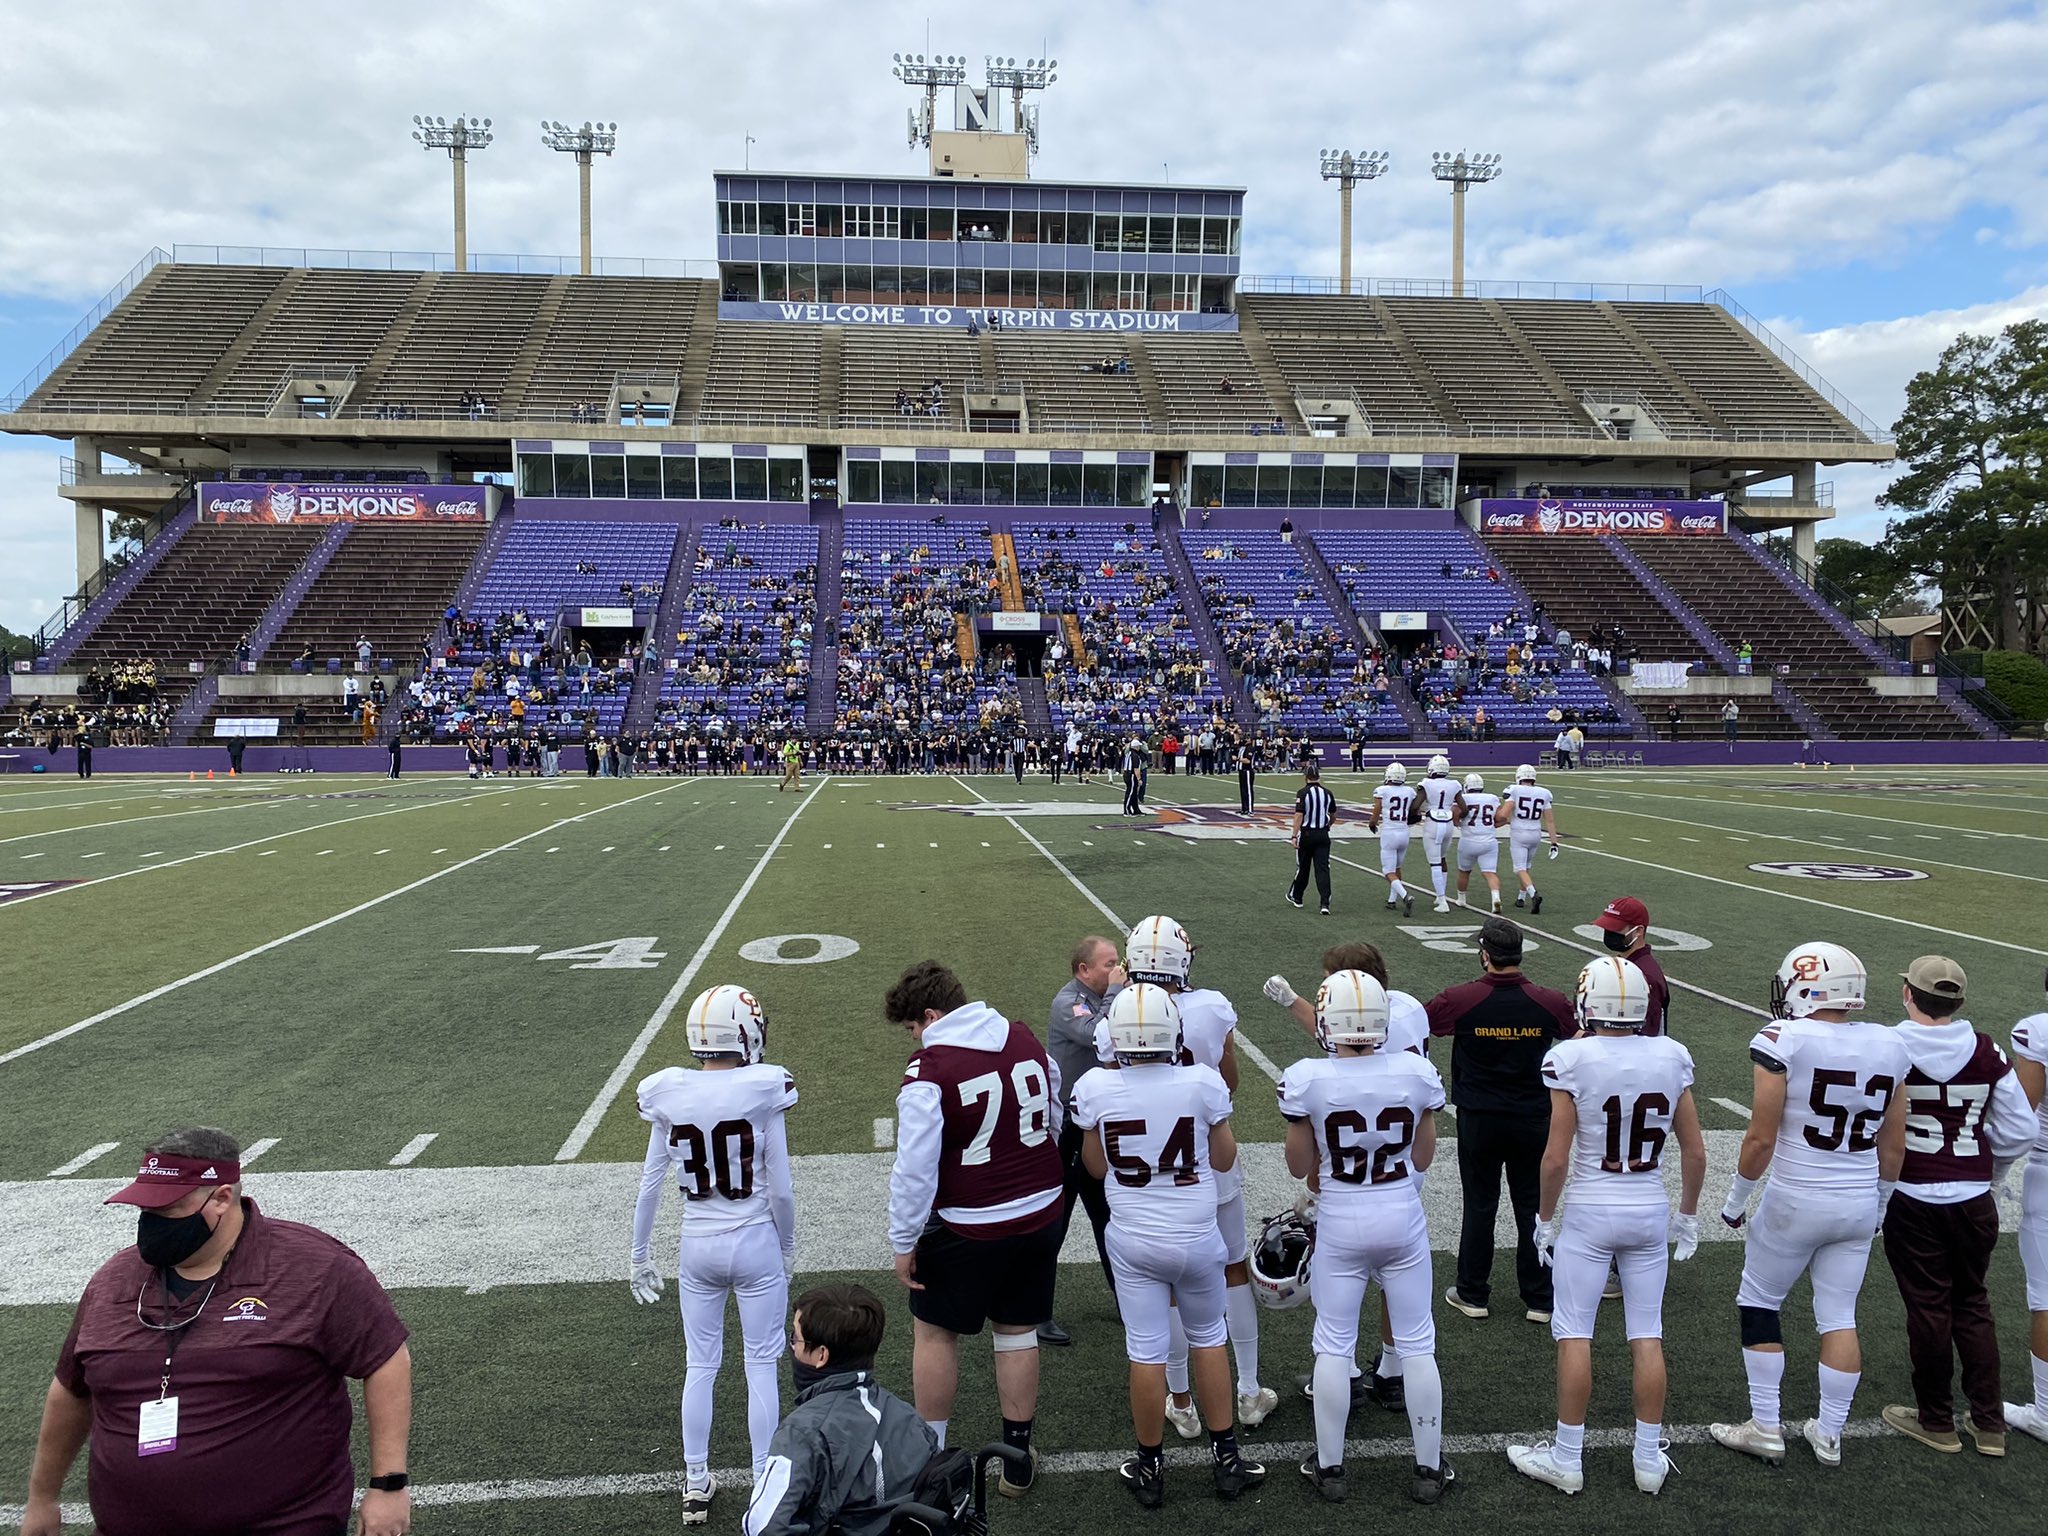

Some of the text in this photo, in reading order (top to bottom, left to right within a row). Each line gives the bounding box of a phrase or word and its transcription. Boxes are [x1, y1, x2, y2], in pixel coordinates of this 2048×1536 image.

[955, 84, 998, 131] N
[780, 304, 906, 325] WELCOME
[920, 307, 952, 325] TO
[1070, 311, 1181, 331] STADIUM
[299, 496, 416, 518] DEMONS
[1565, 510, 1665, 529] DEMONS
[1389, 796, 1409, 822] 21
[1438, 790, 1445, 810] 1
[1517, 796, 1545, 821] 56
[1467, 804, 1494, 827] 76
[1136, 973, 1172, 982] Riddell
[1474, 1027, 1543, 1037] GRAND LAKE
[957, 1059, 1050, 1166] 78
[1803, 1068, 1895, 1153] 52
[1905, 1083, 1990, 1157] 57
[1324, 1106, 1415, 1185] 62
[1600, 1092, 1670, 1174] 16
[669, 1118, 755, 1201] 30
[1103, 1116, 1201, 1188] 54
